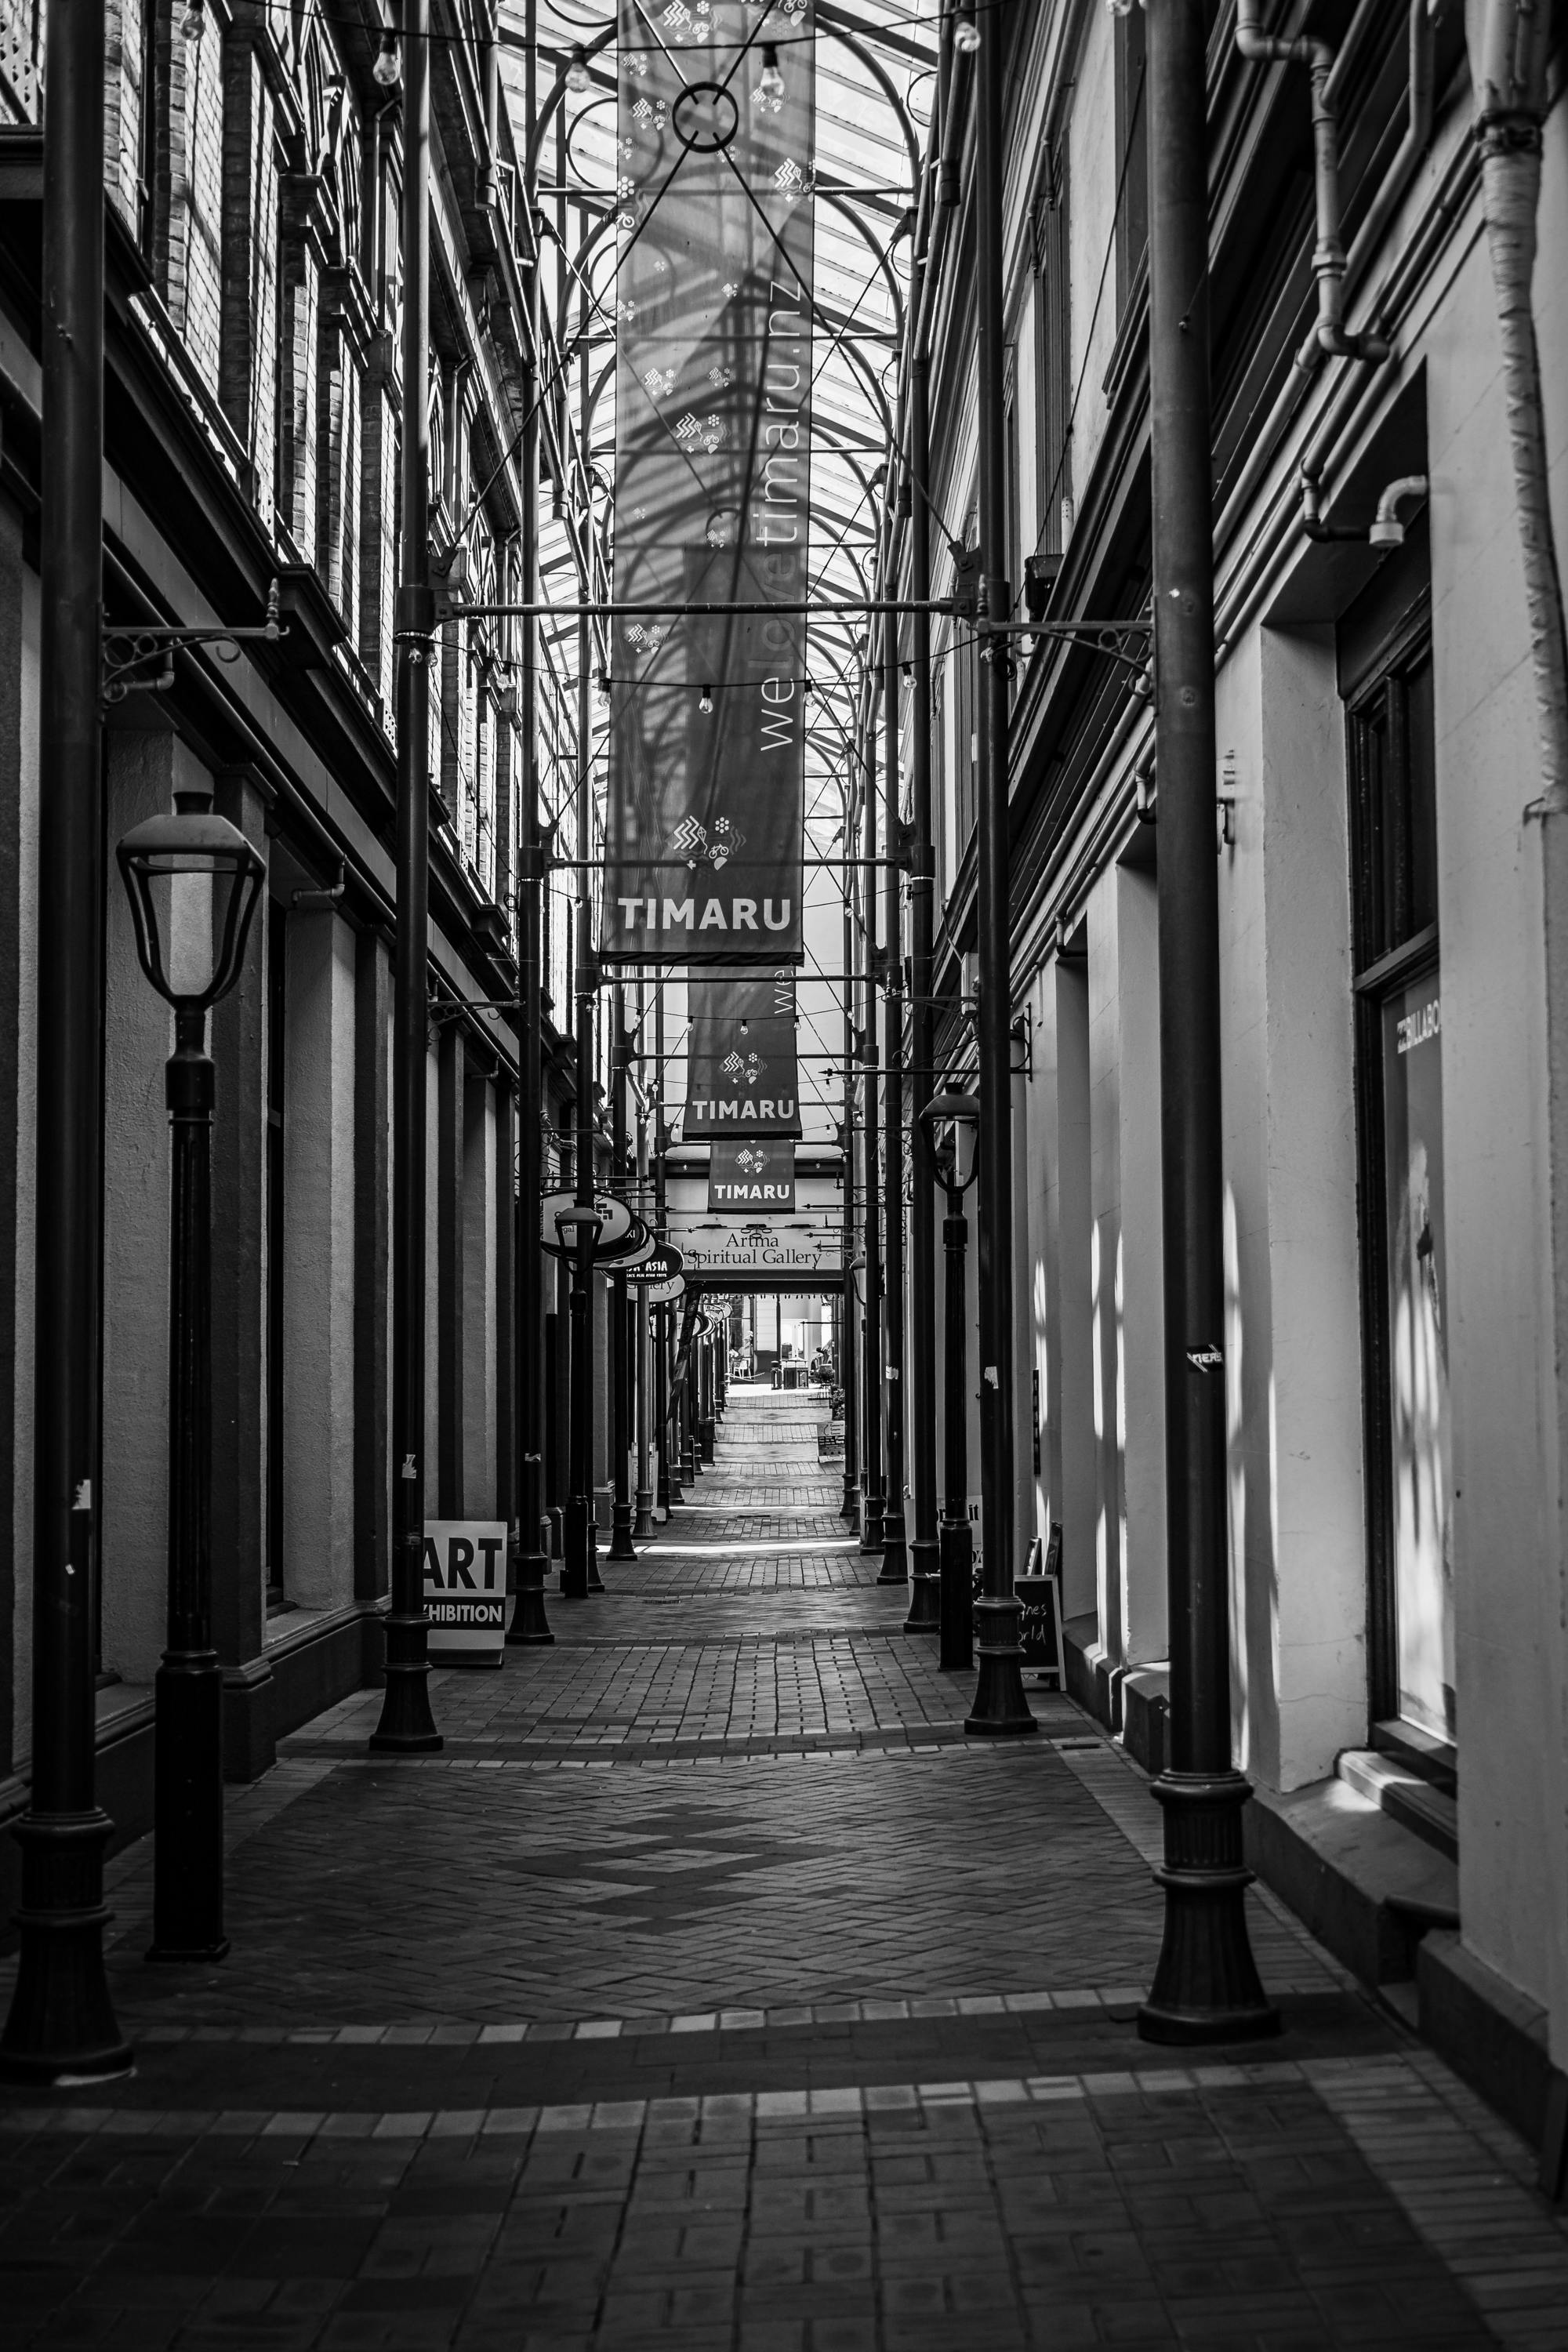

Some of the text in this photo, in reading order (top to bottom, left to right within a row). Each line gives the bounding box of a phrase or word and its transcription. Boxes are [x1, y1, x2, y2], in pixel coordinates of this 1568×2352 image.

[753, 281, 800, 547] timaru.nz
[760, 677, 795, 752] we
[618, 898, 790, 931] TIMARU
[692, 1100, 794, 1120] TIMARU
[714, 1185, 789, 1200] TIMARU
[725, 1232, 779, 1247] Artma
[645, 1261, 667, 1271] ASIA
[688, 1249, 822, 1269] Spiritual Gallery
[424, 1537, 503, 1589] ART
[424, 1605, 502, 1622] HIBITION
[1019, 1624, 1047, 1645] orld
